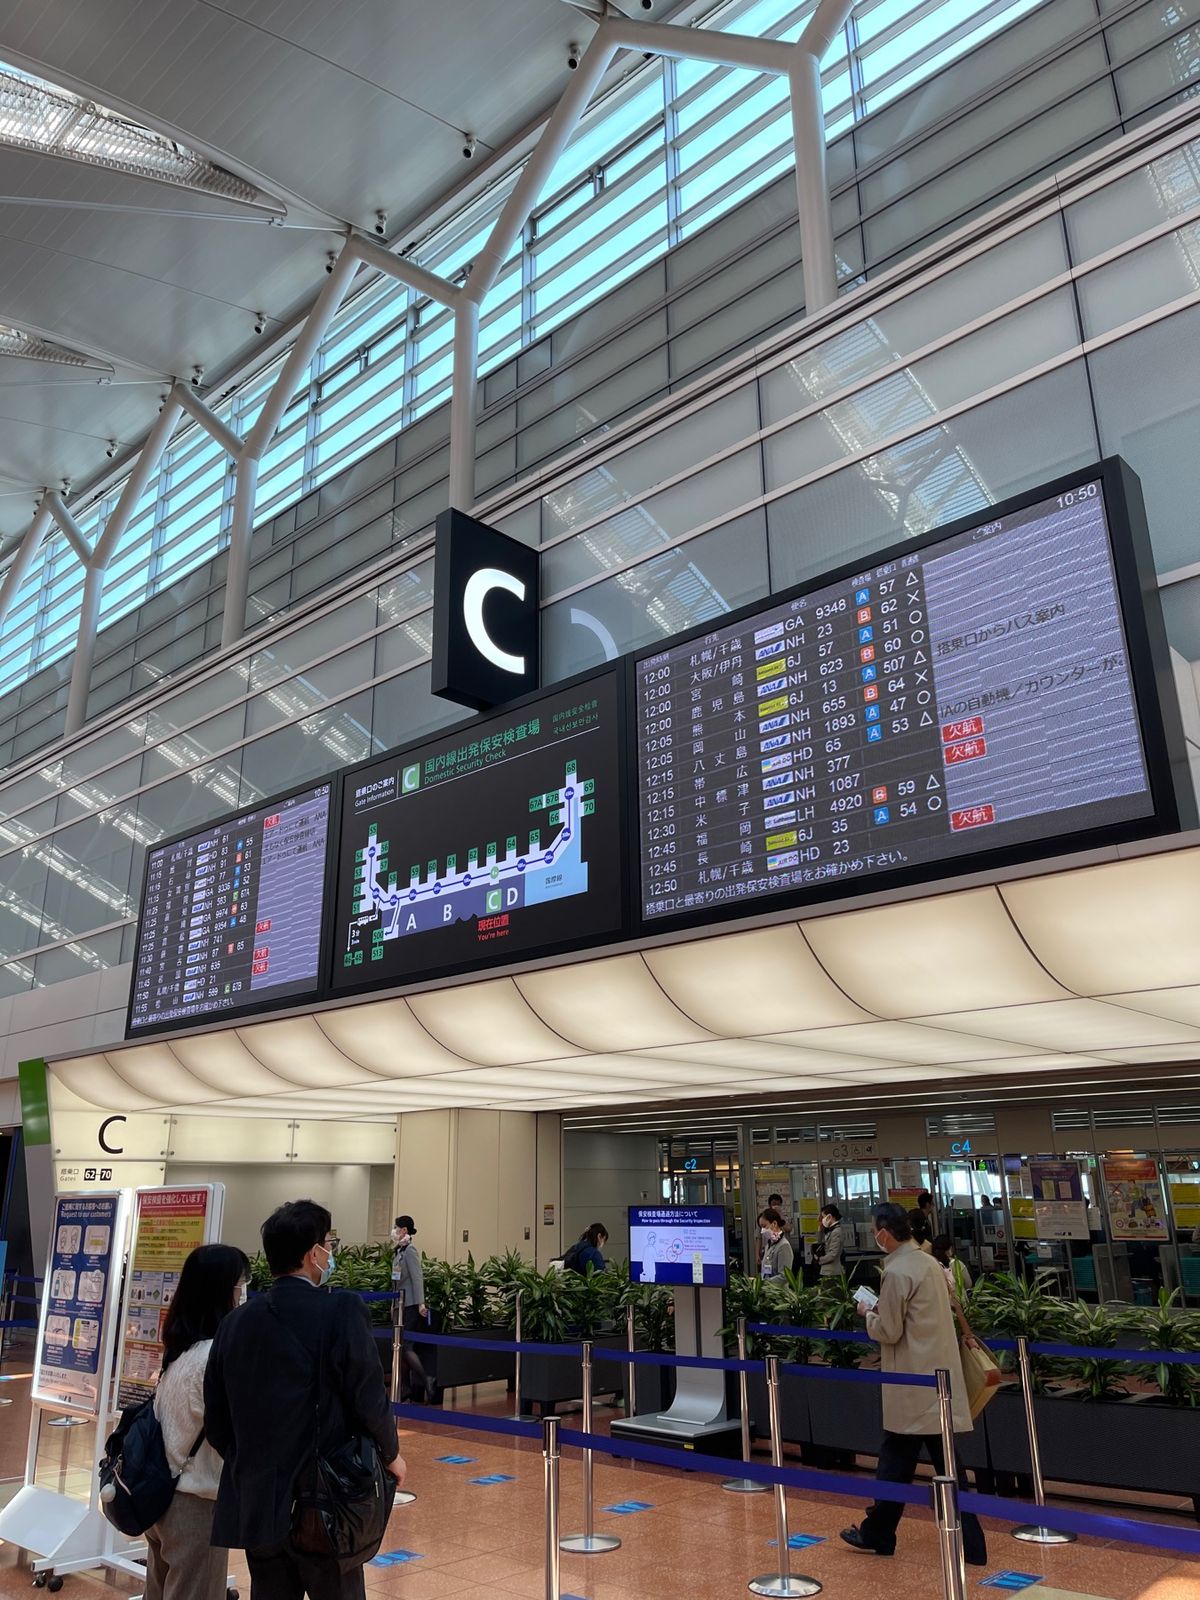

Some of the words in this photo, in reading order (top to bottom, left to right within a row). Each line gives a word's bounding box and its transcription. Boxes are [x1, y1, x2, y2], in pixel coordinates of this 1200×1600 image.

[1056, 483, 1097, 510] 10:50
[463, 568, 525, 675] C
[644, 666, 670, 684] 12:00
[689, 638, 742, 666] 札幌/千歳
[784, 615, 804, 630] GA
[815, 598, 846, 619] 9348
[879, 578, 895, 594] 57
[644, 683, 670, 701] 12:00
[690, 655, 742, 684] 大阪/伊丹
[757, 645, 775, 659] ANA
[786, 632, 805, 649] NH
[817, 623, 832, 638] 23
[881, 598, 897, 613] 62
[644, 700, 671, 718] 12:00
[787, 652, 800, 667] 6J
[818, 641, 833, 656] 57
[883, 618, 897, 633] 51
[645, 717, 671, 734] 12:00
[759, 681, 777, 695] ANA
[788, 670, 807, 686] NH
[819, 658, 843, 675] 623
[884, 637, 901, 652] 60
[645, 734, 672, 752] 12:05
[789, 690, 803, 704] 6J
[822, 679, 836, 694] 13
[883, 655, 905, 673] 507
[646, 751, 672, 769] 12:05
[761, 718, 780, 732] ANA
[791, 707, 810, 724] NH
[822, 696, 846, 713] 655
[888, 677, 905, 692] 64
[646, 769, 673, 786] 12:15
[763, 737, 781, 751] ANA
[791, 726, 811, 742] NH
[824, 713, 855, 732] 1893
[889, 696, 906, 711] 47
[647, 786, 674, 804] 12:15
[793, 746, 812, 762] HD
[825, 737, 841, 752] 65
[892, 717, 909, 733] 53
[939, 652, 1125, 720] Aの自動機／カウンターが
[404, 766, 415, 788] C
[424, 717, 540, 774] 国内線出発保安検査場
[424, 766, 453, 785] Domestic
[456, 756, 483, 775] Security
[485, 747, 506, 763] Check
[566, 761, 575, 773] 68
[647, 804, 674, 822] 12:15
[765, 775, 784, 789] ANA
[794, 765, 814, 782] NH
[827, 754, 850, 772] 377
[948, 719, 977, 738] 欠航
[354, 797, 366, 807] Gate
[367, 787, 394, 803] Information
[530, 797, 542, 809] 67A
[545, 792, 559, 804] 67B
[584, 781, 593, 792] 69
[584, 801, 593, 812] 70
[647, 823, 675, 840] 12:30
[766, 795, 785, 808] ANA
[796, 785, 815, 801] NH
[829, 773, 860, 792] 1087
[950, 741, 980, 759] 欠航
[531, 831, 538, 841] 65
[550, 812, 559, 823] 66
[648, 841, 675, 858] 12:45
[797, 805, 814, 821] LH
[830, 794, 862, 812] 4920
[898, 780, 914, 795] 59
[469, 850, 476, 859] 62
[487, 844, 495, 854] 63
[507, 838, 515, 848] 64
[648, 860, 676, 876] 12:45
[798, 827, 812, 841] 6J
[831, 818, 848, 833] 35
[900, 801, 917, 817] 54
[649, 879, 677, 895] 12:50
[698, 860, 753, 884] 札幌/千歳
[800, 846, 820, 862] HD
[833, 839, 849, 855] 23
[957, 807, 988, 824] 欠航
[407, 913, 416, 930] A
[443, 903, 452, 922] B
[488, 890, 498, 910] C
[507, 886, 517, 905] D
[478, 931, 495, 941] You're
[497, 928, 508, 937] here
[98, 1115, 127, 1155] C
[951, 1139, 972, 1154] c4
[684, 1158, 697, 1170] c2
